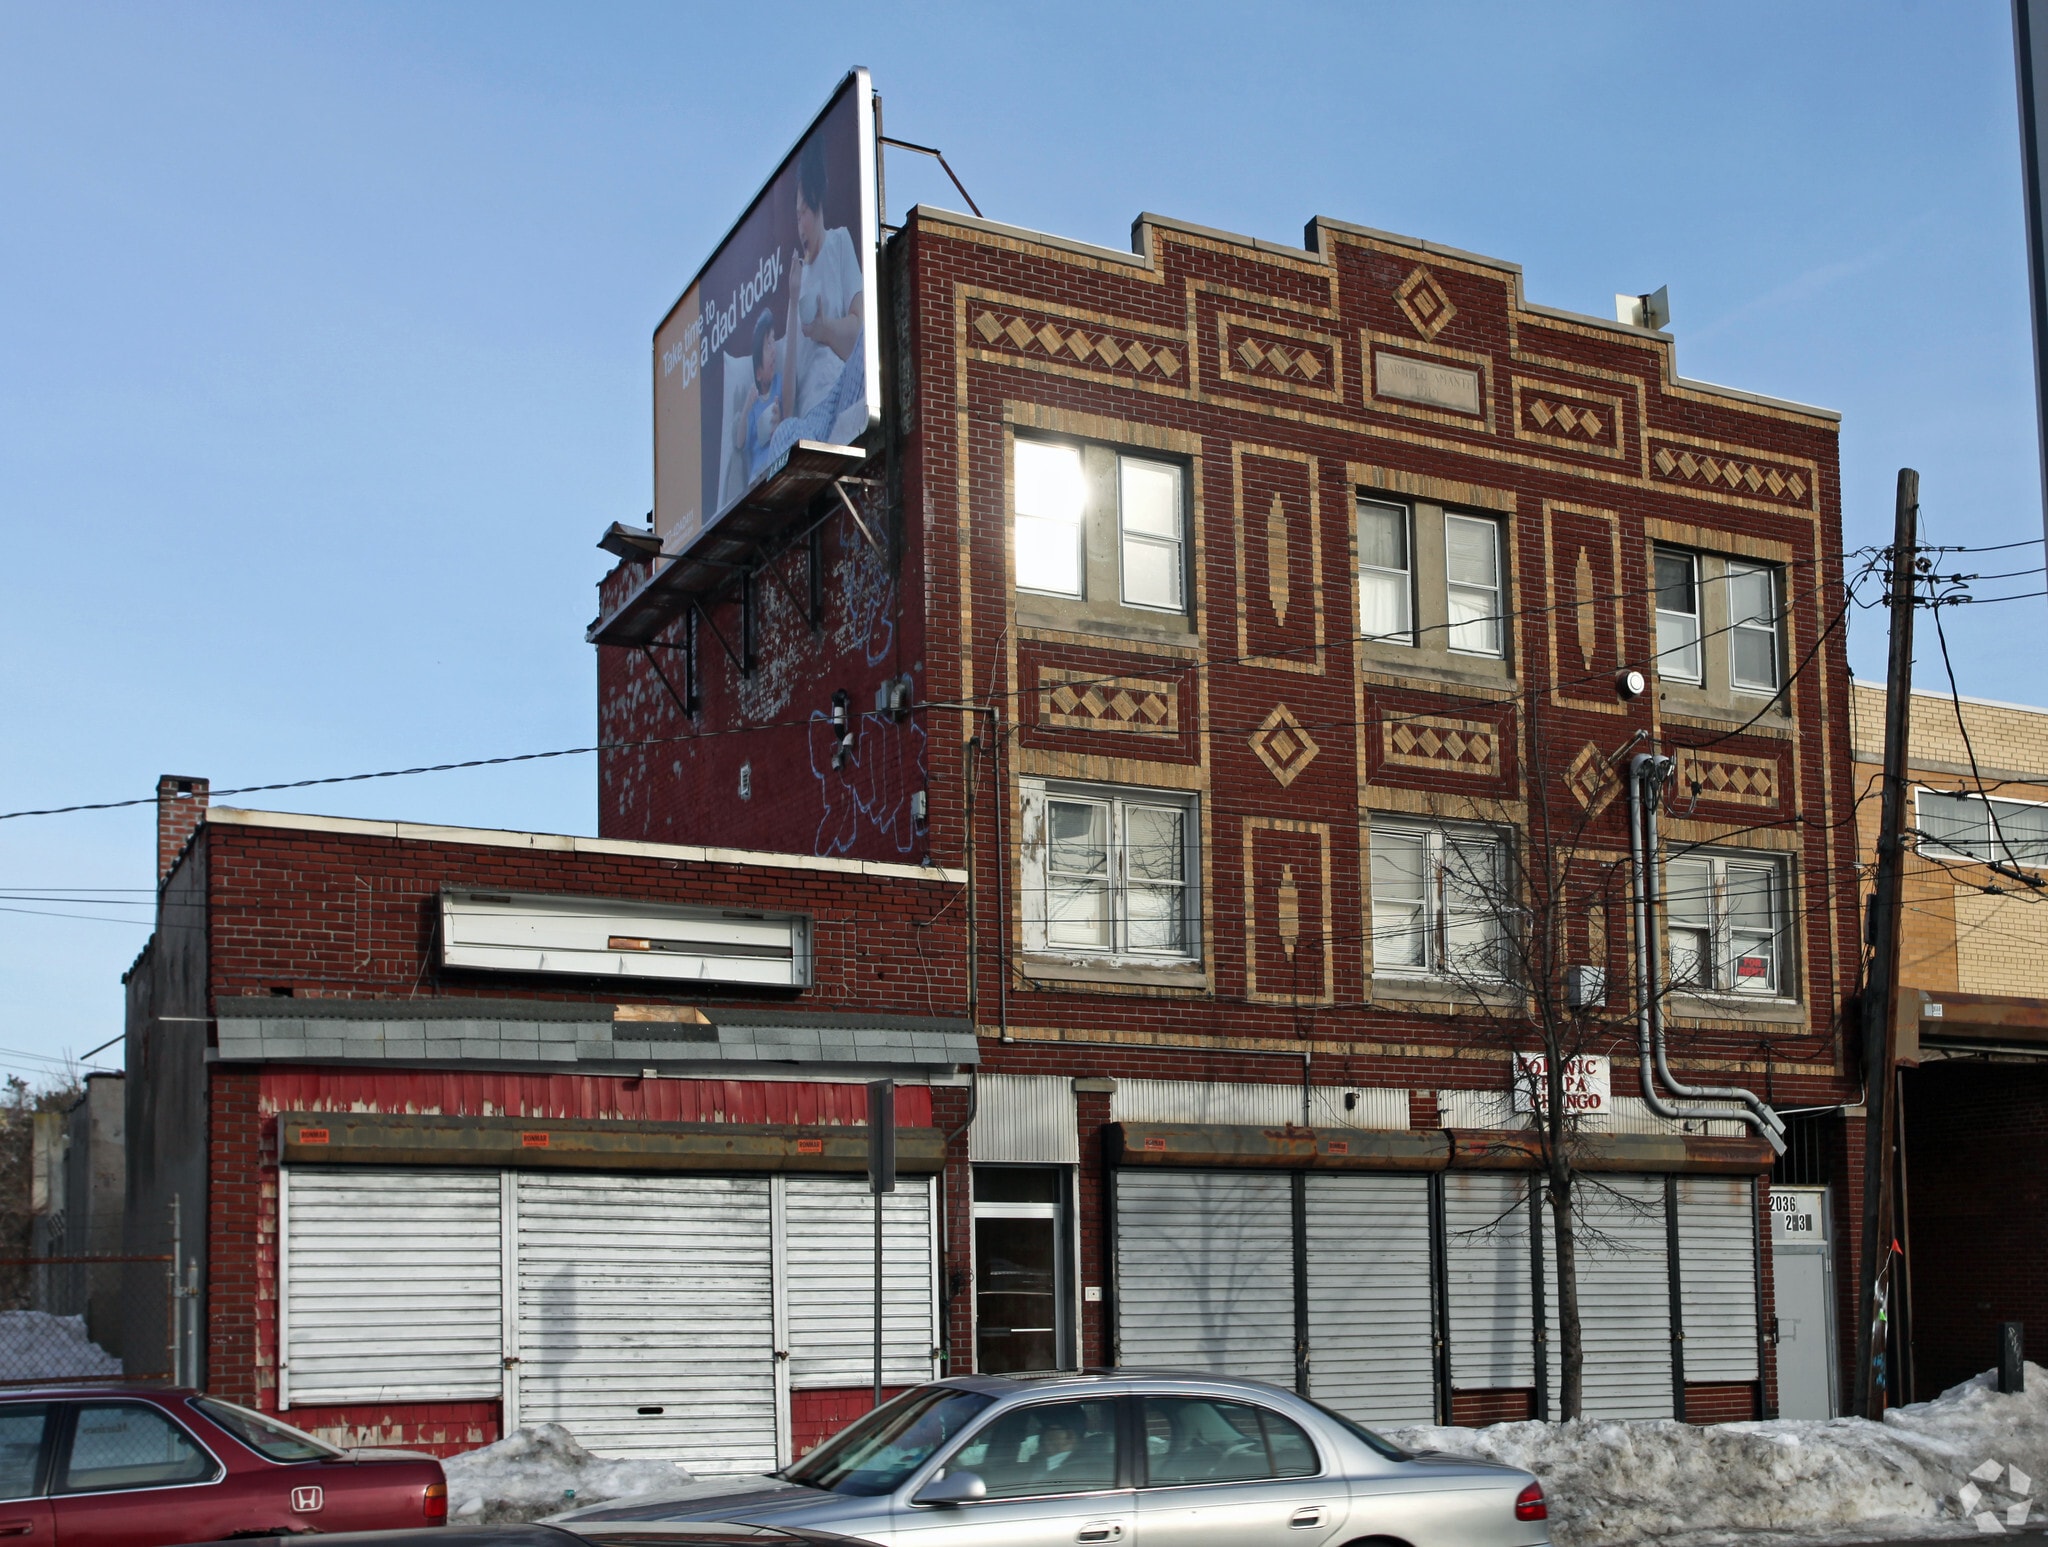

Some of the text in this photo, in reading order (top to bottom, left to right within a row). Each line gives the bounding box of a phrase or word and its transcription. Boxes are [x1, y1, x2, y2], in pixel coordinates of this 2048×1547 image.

[682, 246, 783, 390] be a dad today.
[662, 299, 716, 378] Take time to
[1743, 957, 1762, 967] FOR
[1738, 966, 1766, 977] RENT
[1541, 1075, 1588, 1092] PPA
[1769, 1196, 1796, 1212] 2036
